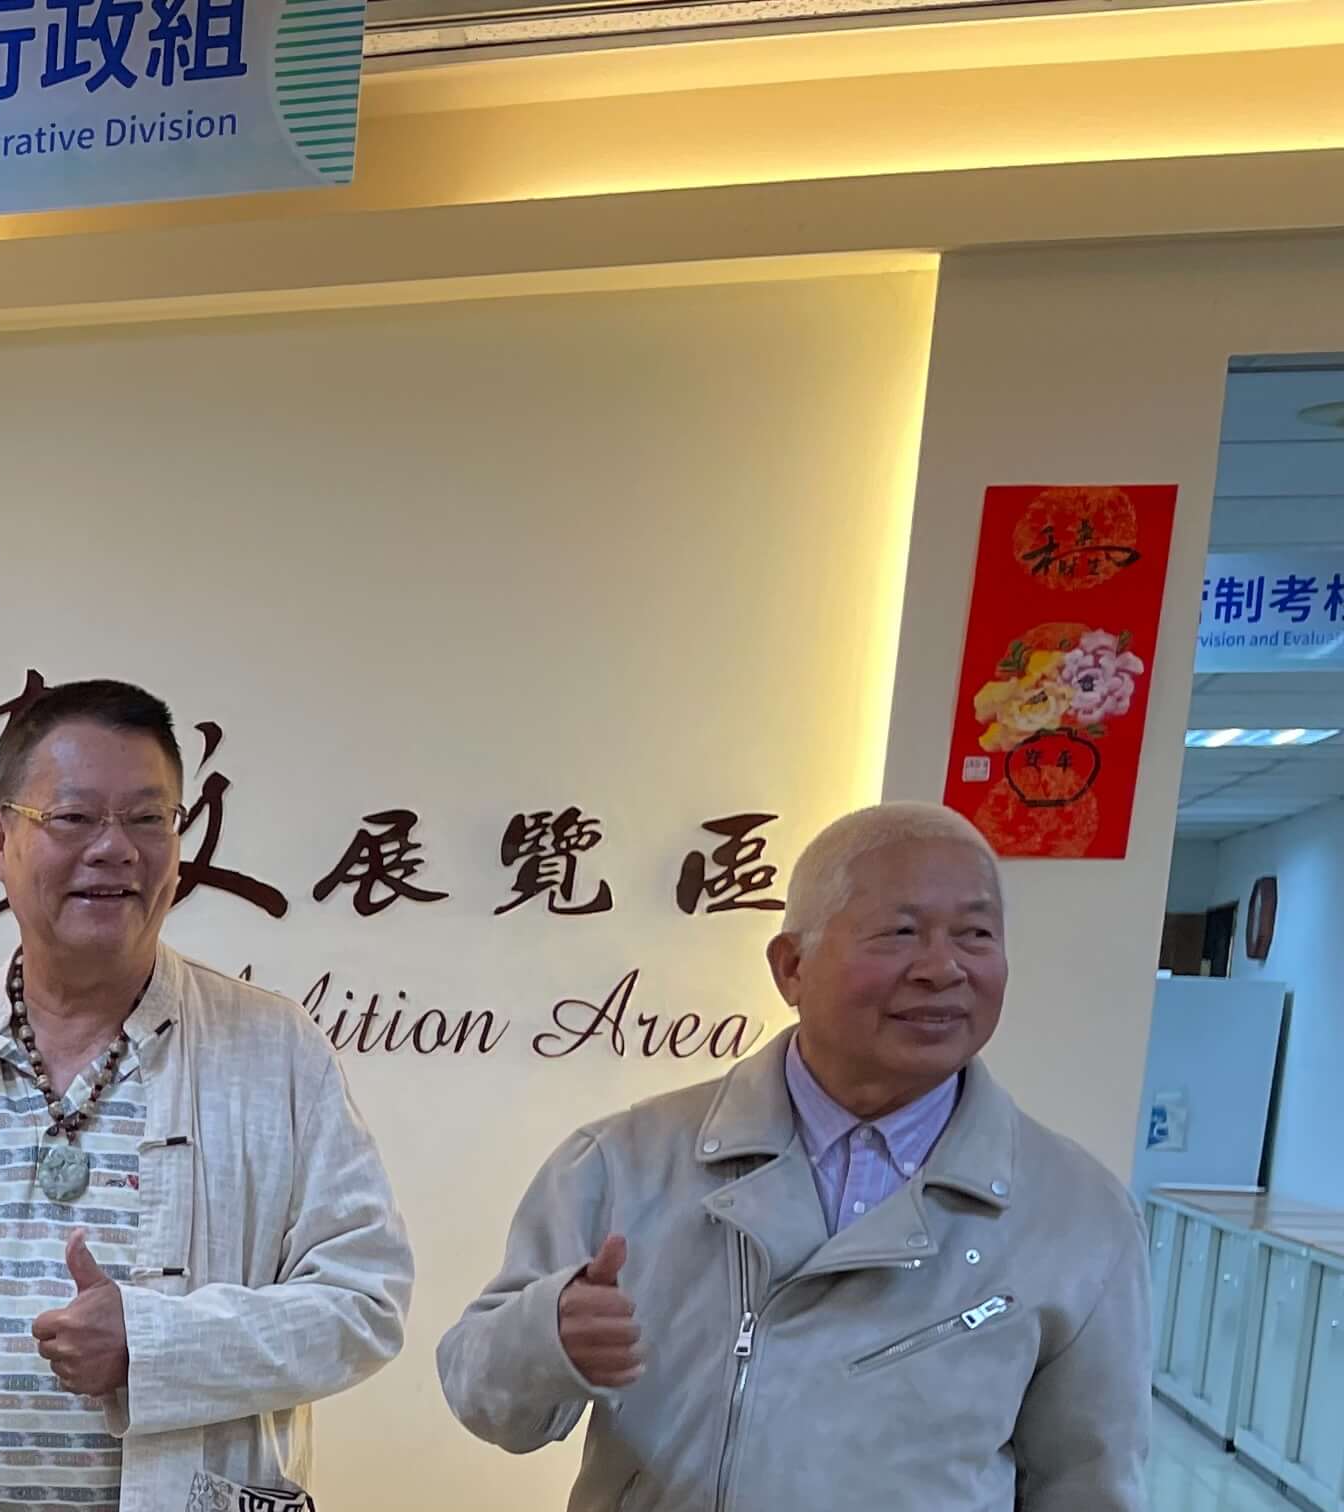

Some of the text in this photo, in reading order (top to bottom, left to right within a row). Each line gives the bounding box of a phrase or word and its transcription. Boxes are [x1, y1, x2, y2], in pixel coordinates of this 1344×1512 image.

[105, 111, 237, 147] Division
[1200, 573, 1344, 624] 制考
[1249, 631, 1280, 646] and
[532, 968, 765, 1058] Area
